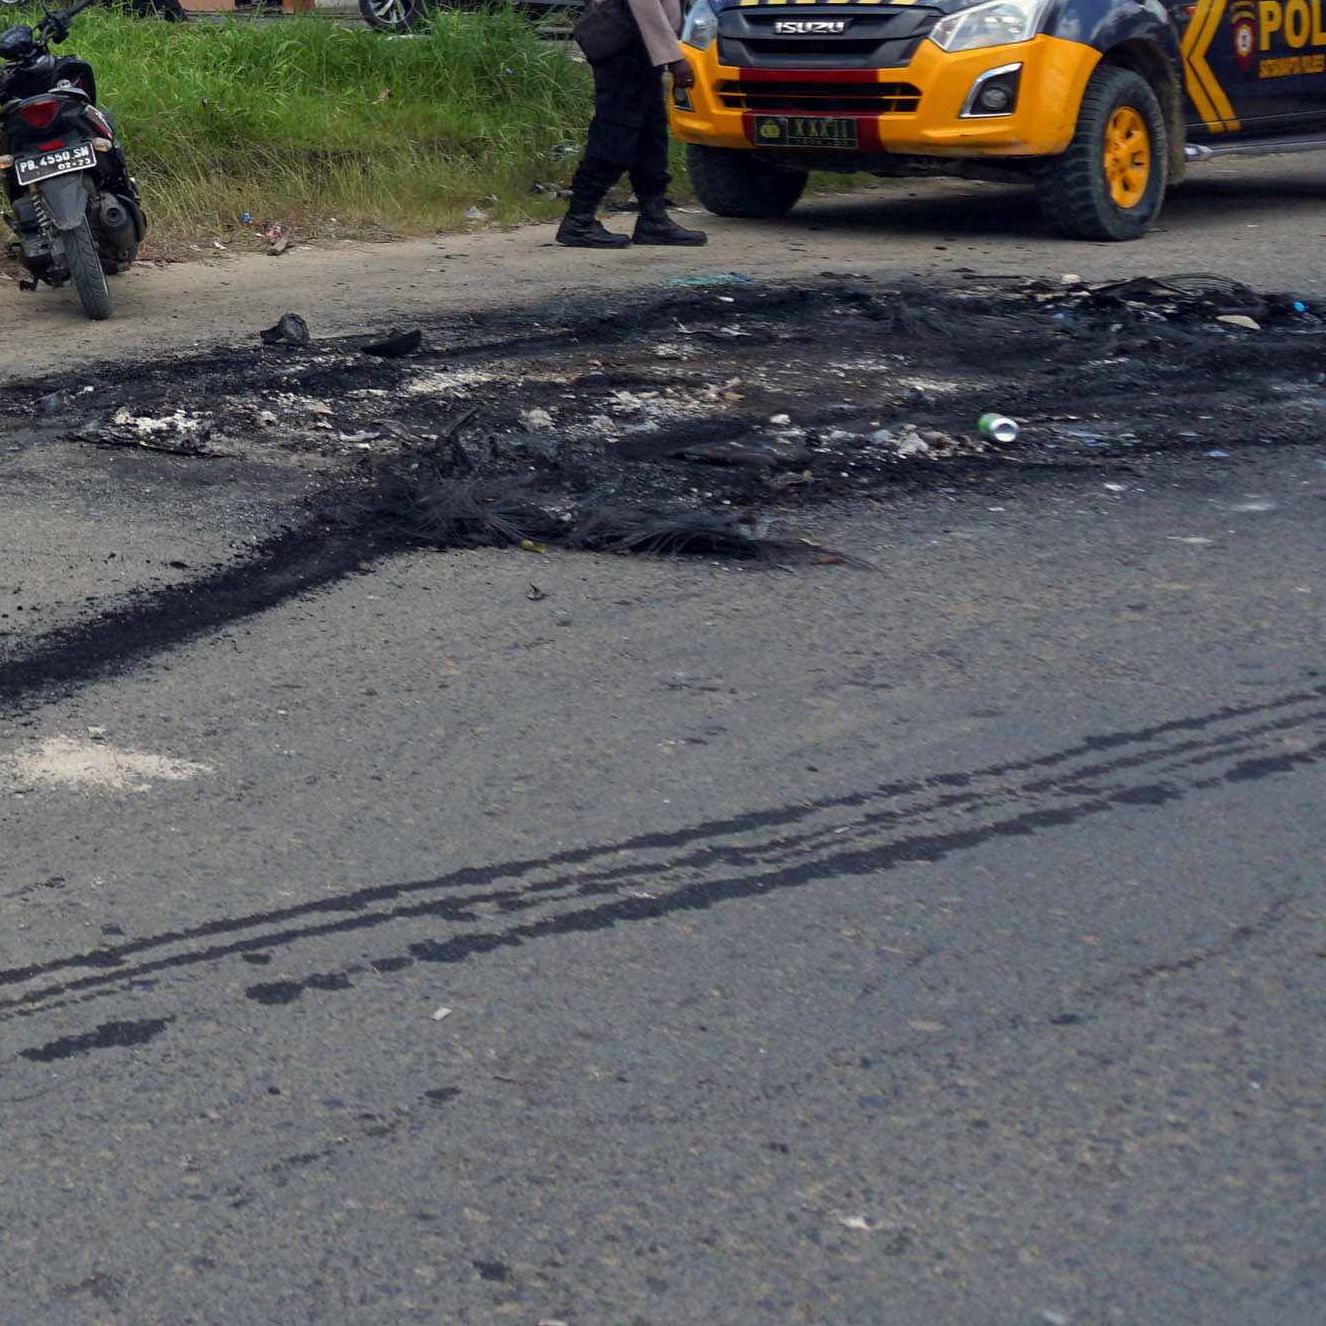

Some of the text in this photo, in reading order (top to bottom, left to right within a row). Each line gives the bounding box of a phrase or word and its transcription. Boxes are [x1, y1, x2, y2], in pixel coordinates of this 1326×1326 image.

[775, 21, 845, 34] ISUZU
[20, 160, 36, 173] PB
[39, 151, 71, 166] 4550
